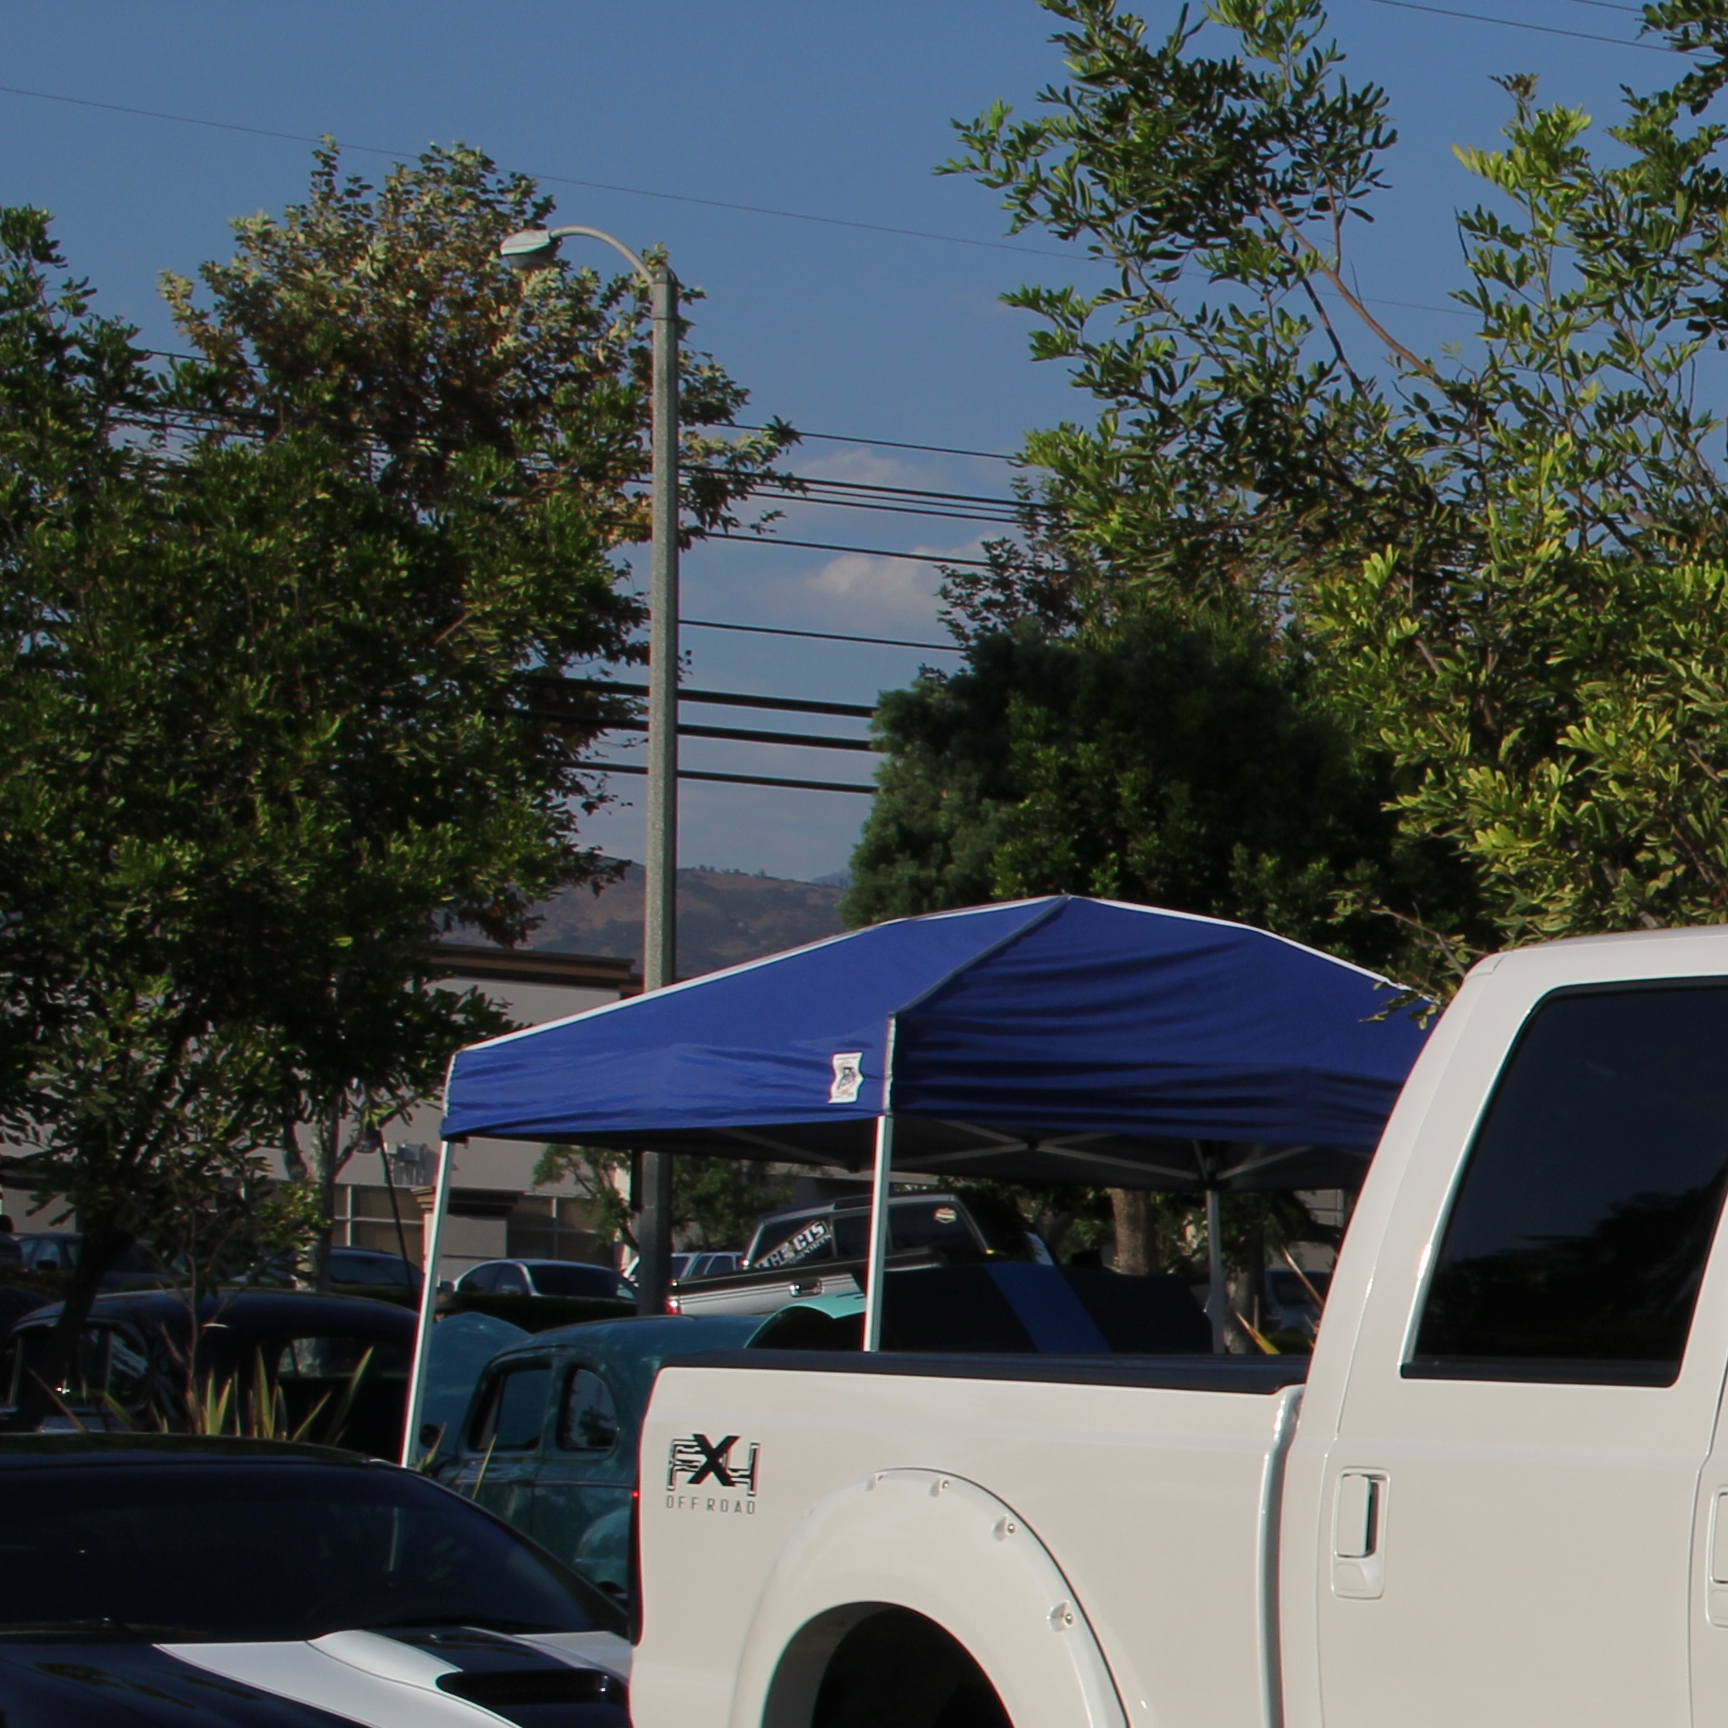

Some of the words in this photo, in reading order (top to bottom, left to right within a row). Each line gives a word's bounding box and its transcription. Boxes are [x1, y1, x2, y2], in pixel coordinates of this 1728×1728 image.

[666, 1433, 761, 1497] FX4
[666, 1495, 700, 1510] OFF
[706, 1497, 757, 1515] ROAD
